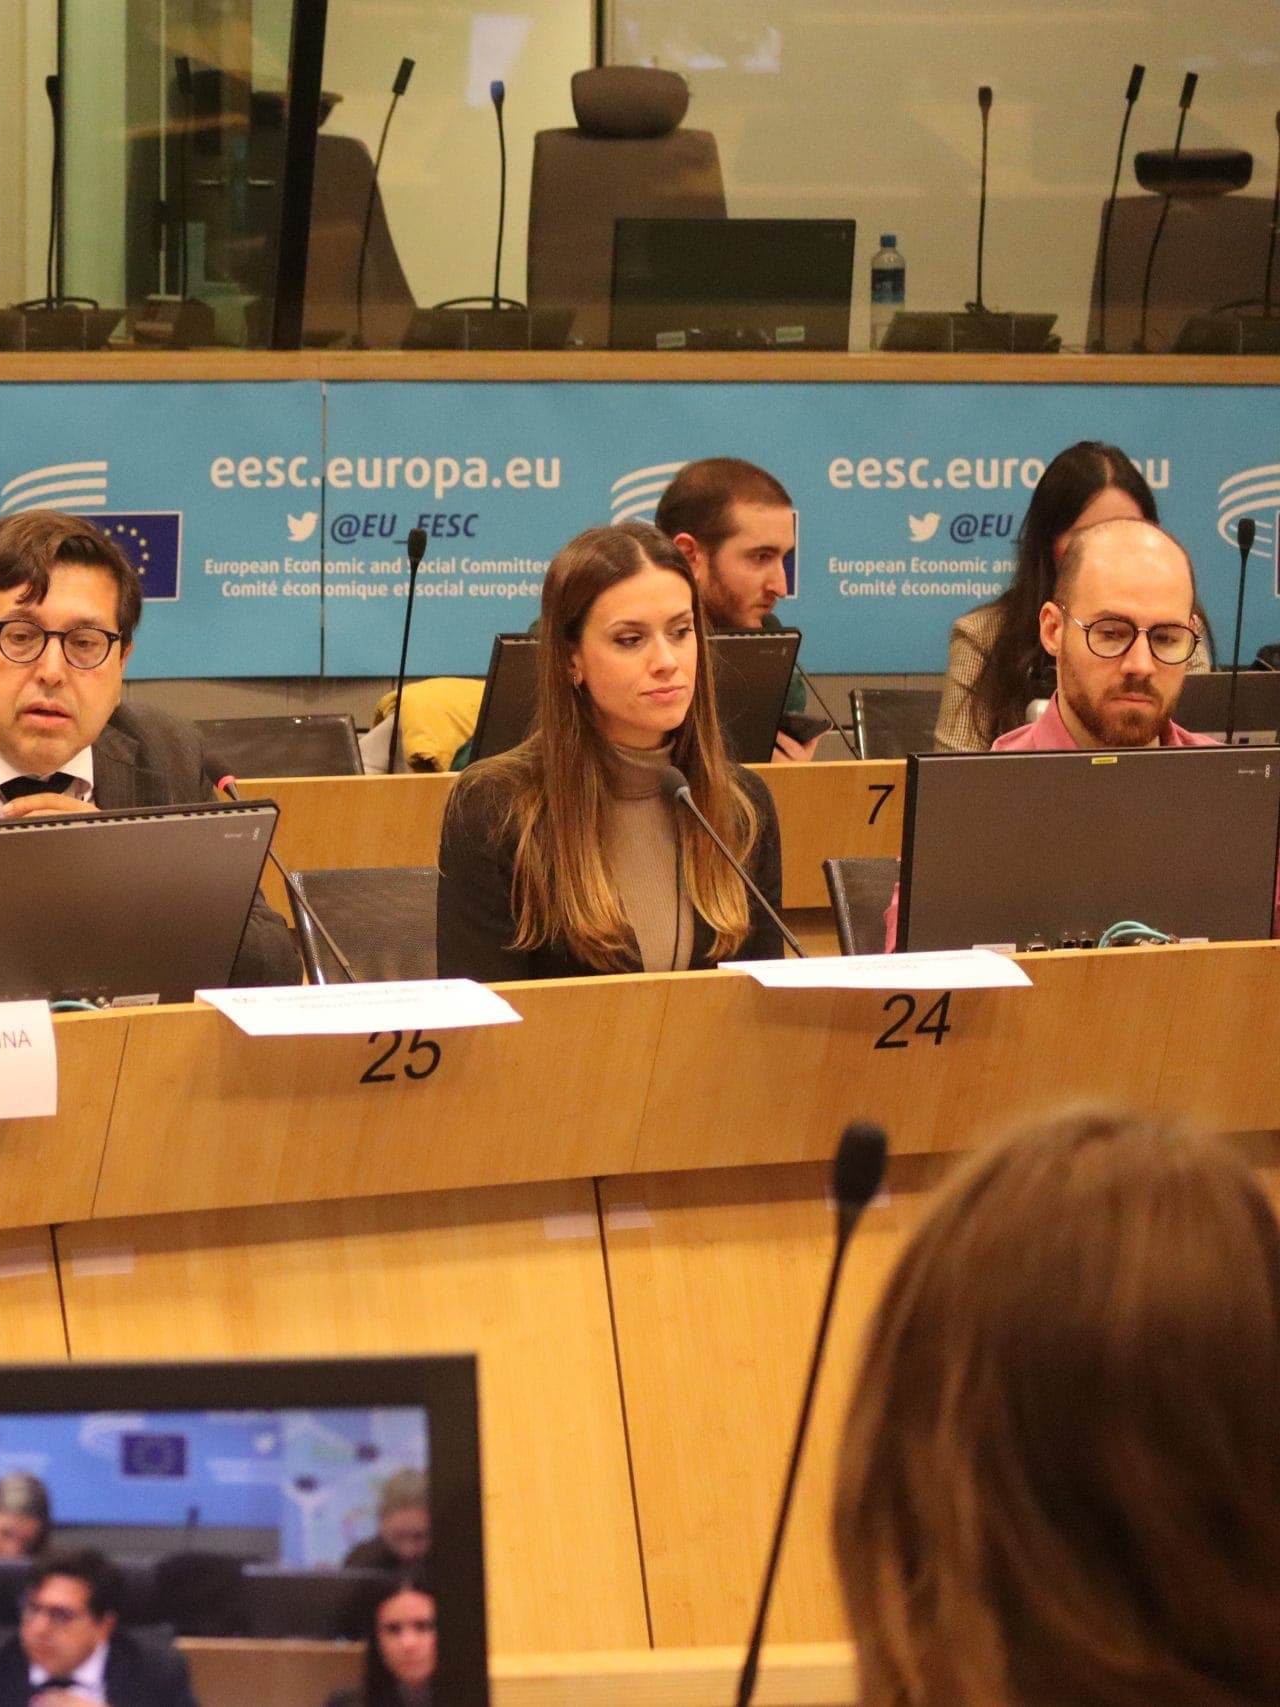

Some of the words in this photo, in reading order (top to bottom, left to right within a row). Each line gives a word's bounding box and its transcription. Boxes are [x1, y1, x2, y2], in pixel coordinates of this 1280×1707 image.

[210, 455, 561, 499] eesc.europa.eu
[204, 558, 280, 577] European
[284, 557, 366, 575] Economic
[370, 557, 402, 575] and
[829, 557, 906, 576] European
[911, 556, 988, 574] Economic
[222, 580, 277, 597] Comité
[282, 579, 388, 600] économique
[415, 579, 464, 597] social
[839, 580, 896, 596] Comité
[901, 579, 1002, 599] économique
[867, 784, 895, 825] 7
[873, 990, 952, 1050] 24
[359, 1029, 442, 1085] 25
